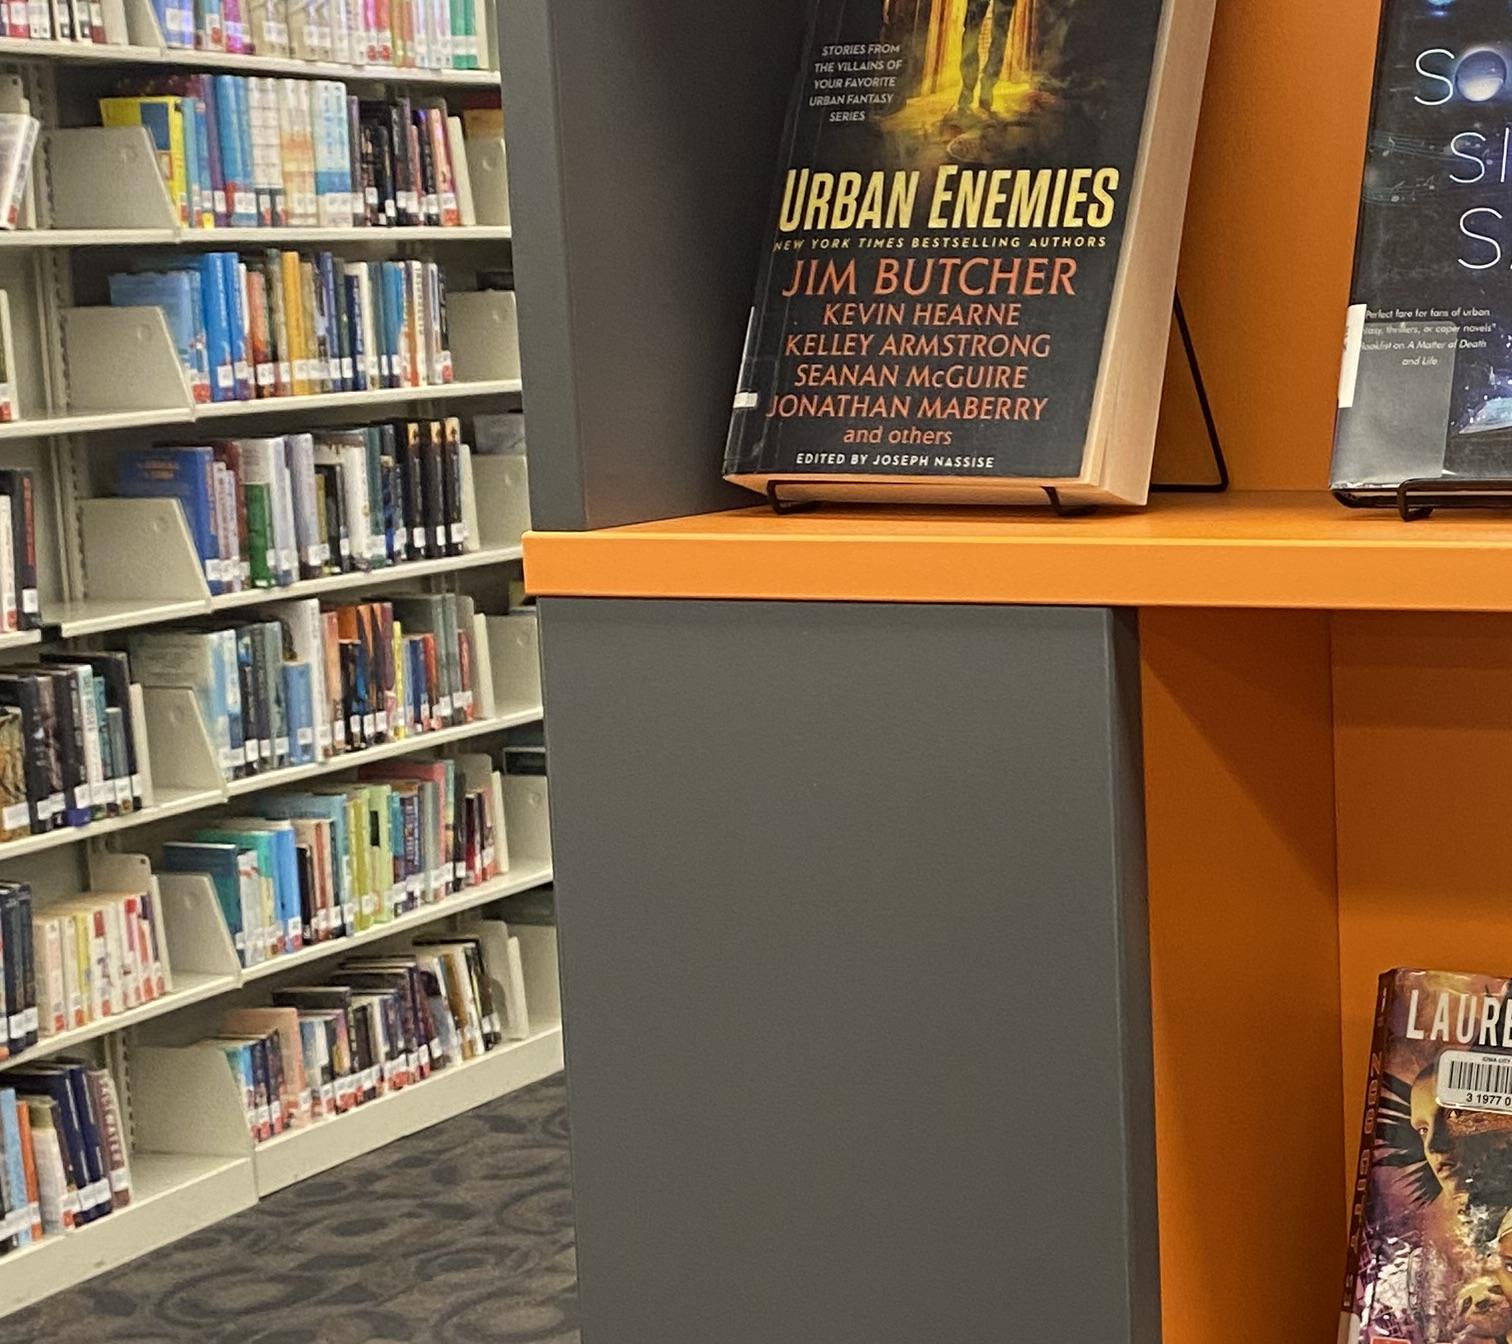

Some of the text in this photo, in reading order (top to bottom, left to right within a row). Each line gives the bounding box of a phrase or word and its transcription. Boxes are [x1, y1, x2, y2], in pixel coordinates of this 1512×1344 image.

[822, 43, 900, 57] STORIES FROM
[814, 59, 903, 73] THE VILLAINS OF
[814, 76, 896, 89] YOUR FAVORITE
[809, 93, 895, 107] URBAN FANTASY
[829, 111, 866, 122] SERIES
[778, 164, 1120, 232] URBAN ENEMIES
[773, 236, 1107, 253] NEW YORK TIMES BESTSELLING AUTHORS
[782, 256, 1078, 297] JIM BUTCHER
[823, 303, 1022, 326] KEVIN HEARNE
[1415, 308, 1428, 317] for
[1451, 307, 1462, 316] of
[1463, 307, 1491, 316] urban
[784, 334, 1051, 357] KELLEY ARMSTRONG
[1407, 340, 1415, 349] A
[1459, 339, 1487, 349] Death
[1402, 356, 1420, 365] and
[794, 364, 1029, 388] SEANAN McGUIRE
[766, 394, 1049, 421] JONATHAN MABERRY
[843, 426, 953, 446] and others
[796, 453, 995, 468] EDITED BY JOSEPH NASSISE
[1466, 1093, 1472, 1102] 3
[1477, 1094, 1502, 1105] 1977
